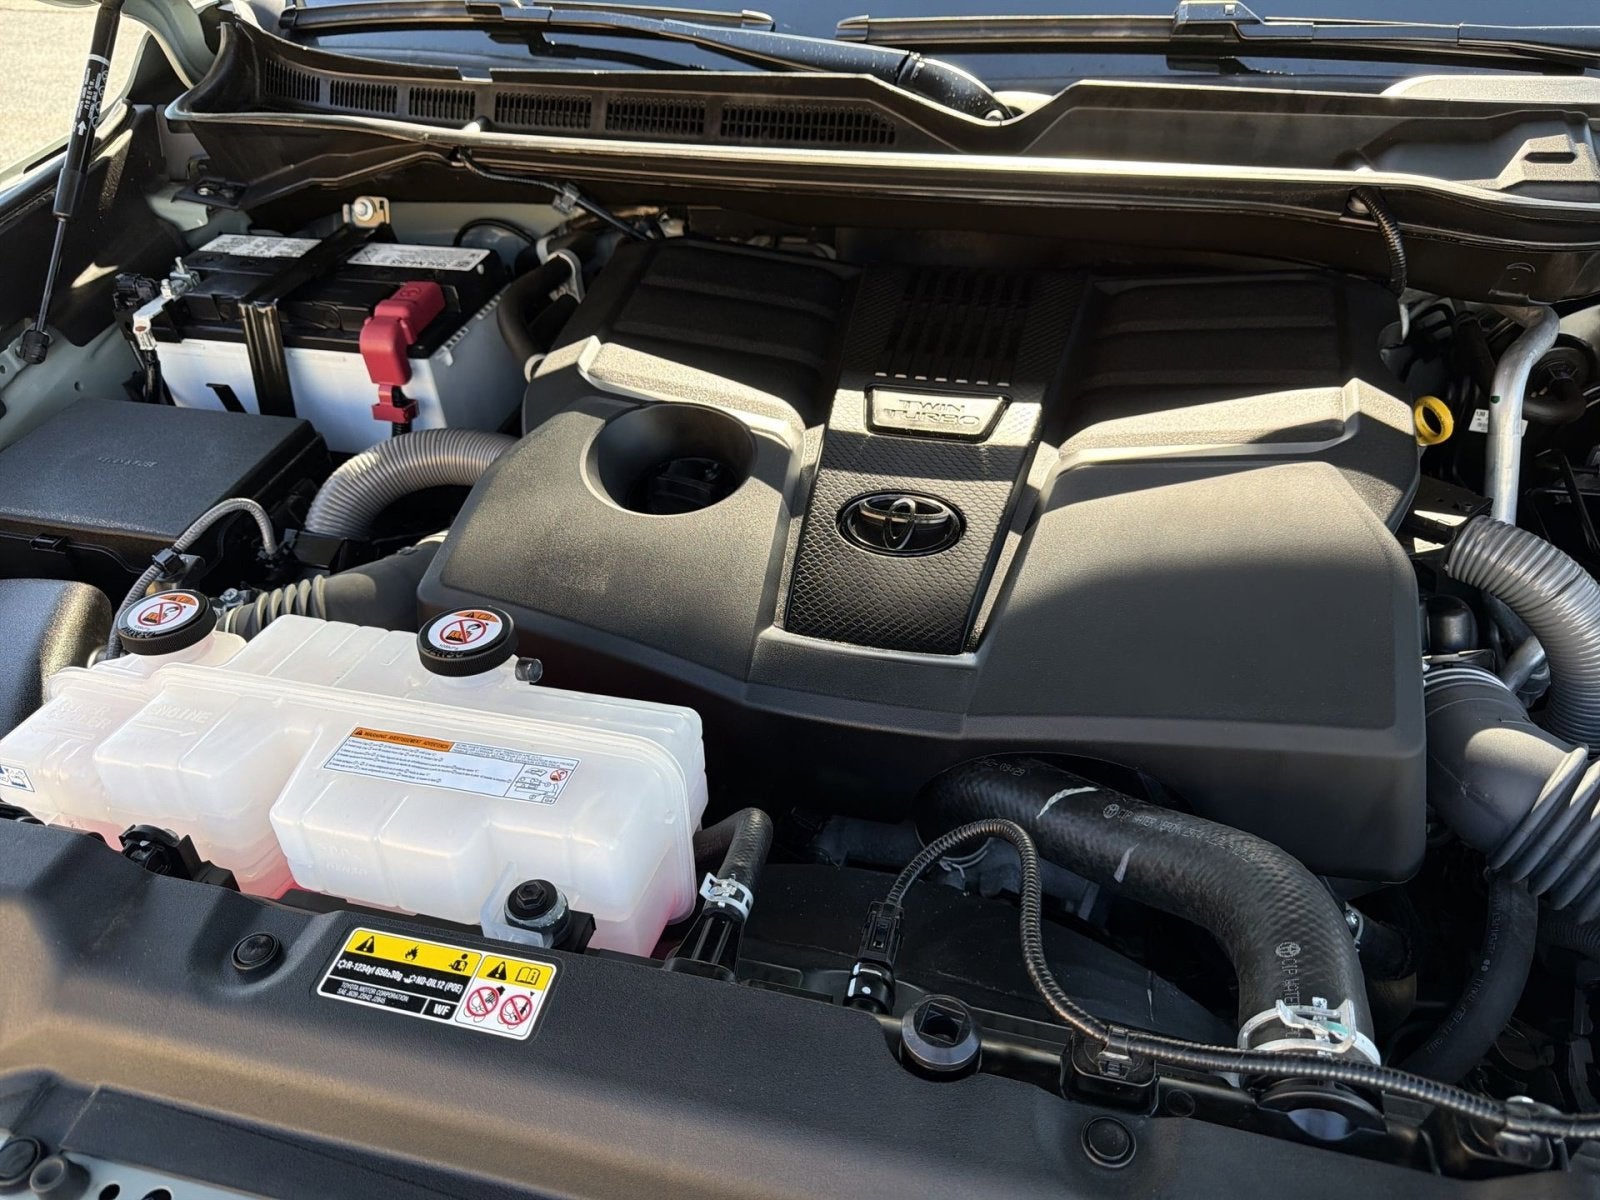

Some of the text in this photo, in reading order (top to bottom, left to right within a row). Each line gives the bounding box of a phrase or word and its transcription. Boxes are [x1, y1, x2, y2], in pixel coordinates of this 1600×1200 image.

[899, 399, 966, 414] TWIN
[883, 408, 981, 425] TURBO
[341, 981, 410, 1002] TOYOTA MOTOR CORPORATION
[445, 981, 463, 995] (POE)
[1283, 978, 1300, 1007] WATE
[432, 1003, 451, 1016] WF
